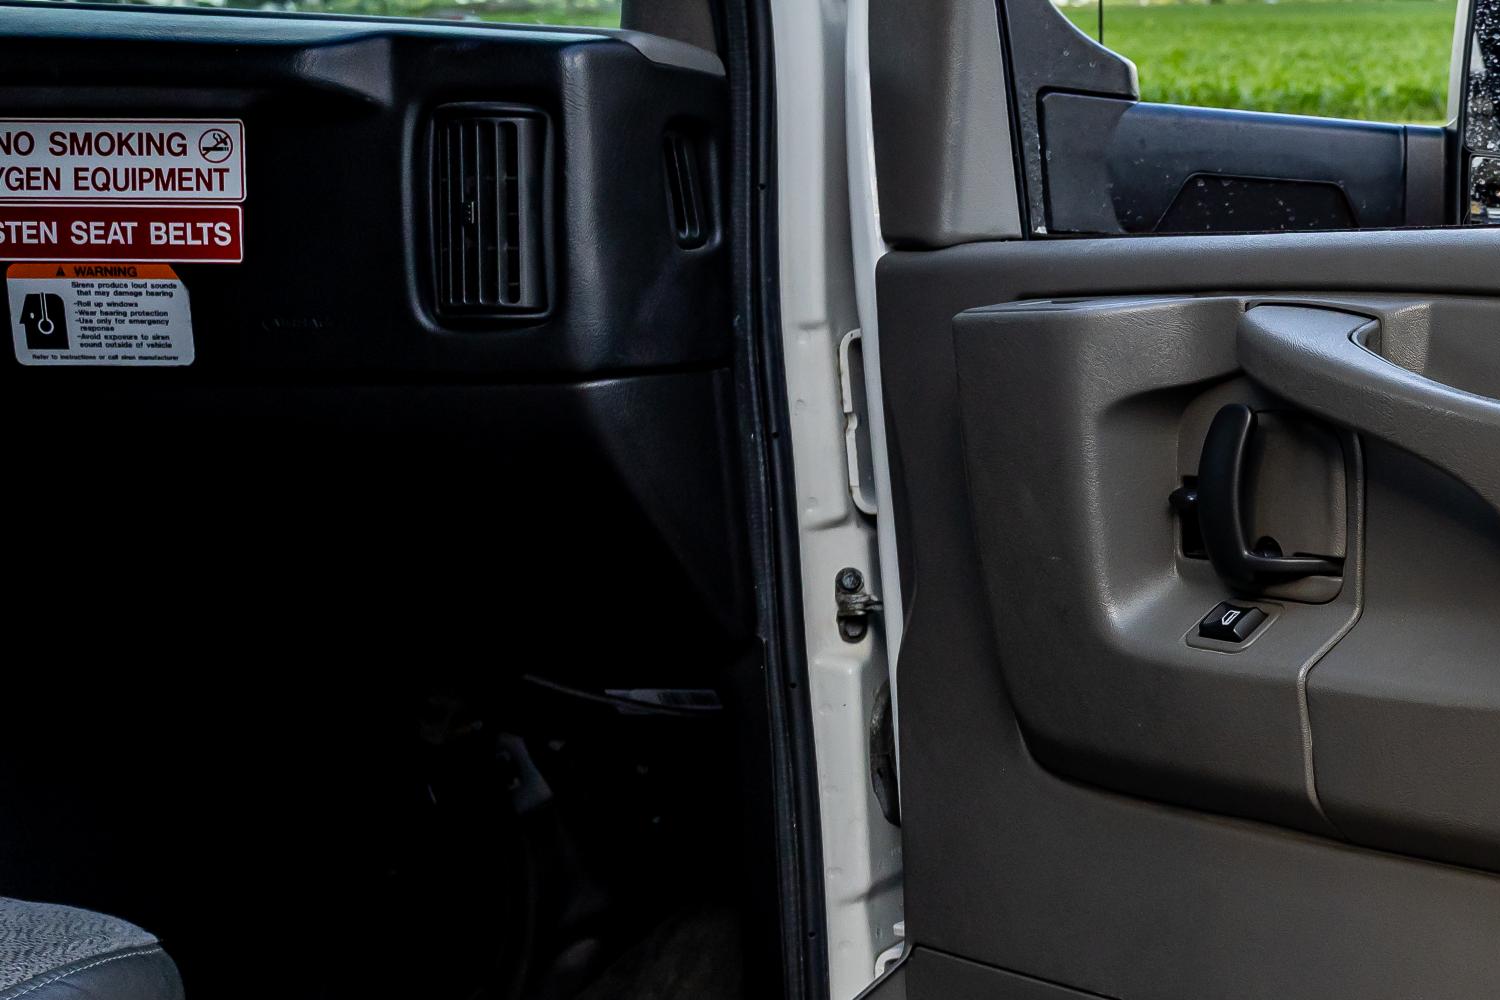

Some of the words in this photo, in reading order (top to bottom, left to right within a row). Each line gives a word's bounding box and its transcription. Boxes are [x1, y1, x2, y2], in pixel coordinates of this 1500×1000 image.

[49, 131, 187, 157] SMOKING
[0, 166, 61, 191] GEN
[74, 167, 229, 192] EQUIPMENT
[71, 221, 138, 245] SEAT
[150, 222, 232, 246] BELTS
[74, 266, 137, 277] WARNING
